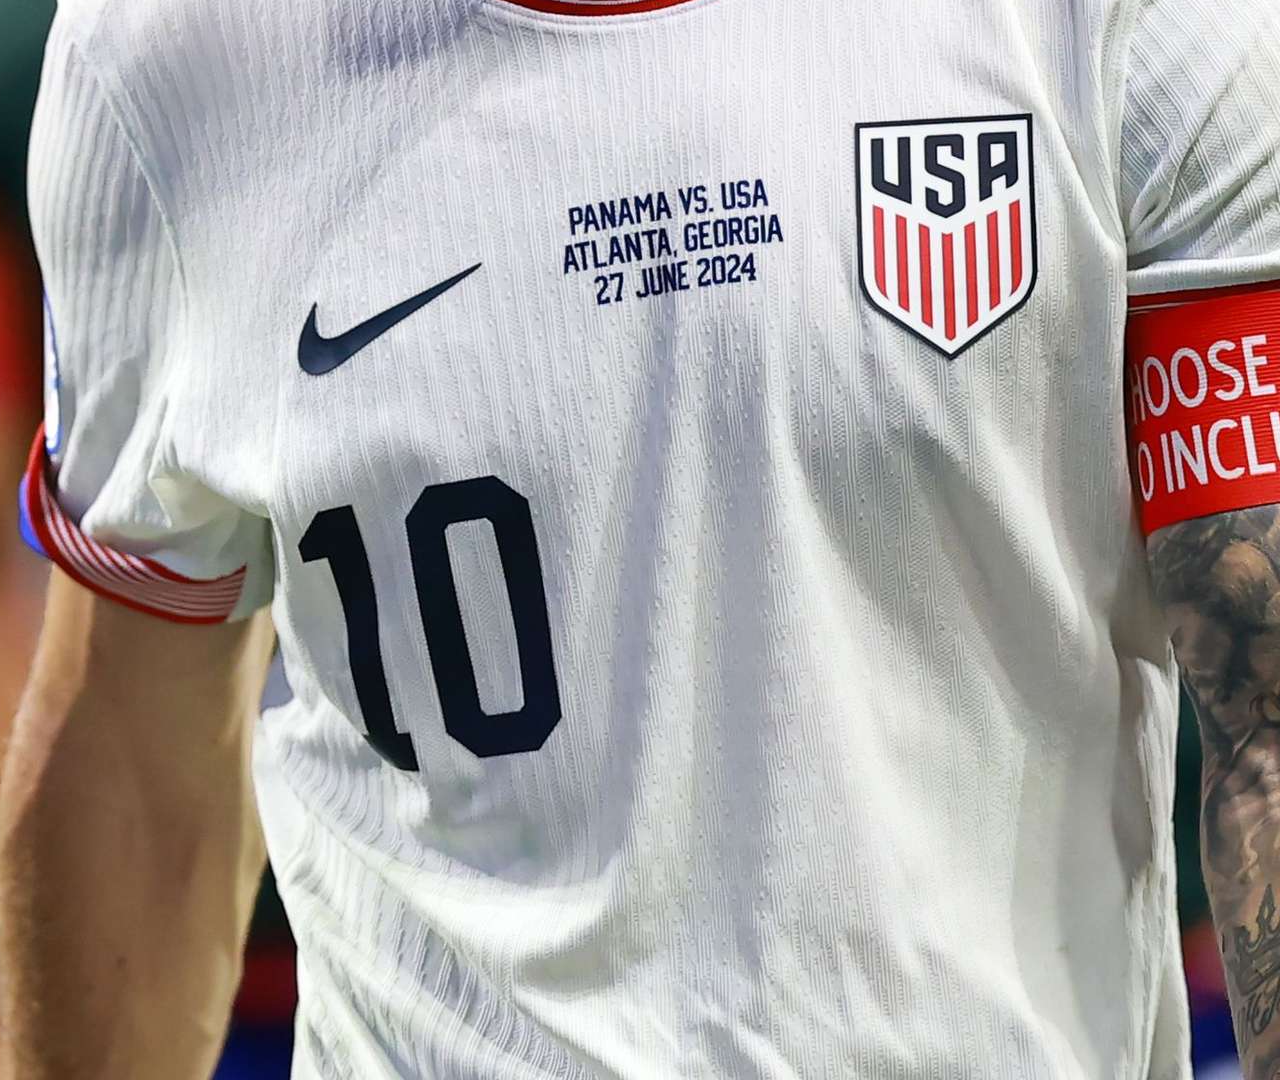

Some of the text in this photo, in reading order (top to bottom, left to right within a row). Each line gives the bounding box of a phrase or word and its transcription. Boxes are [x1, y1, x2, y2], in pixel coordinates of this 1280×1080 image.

[870, 131, 1019, 219] USA
[568, 179, 769, 235] PANAMA VS. USA
[563, 214, 784, 274] ATLANTA, GEORGIA
[594, 252, 757, 305] 27 JUNE 2024
[1129, 333, 1277, 425] HOOSE
[1137, 441, 1155, 502] O
[298, 475, 562, 772] 10
